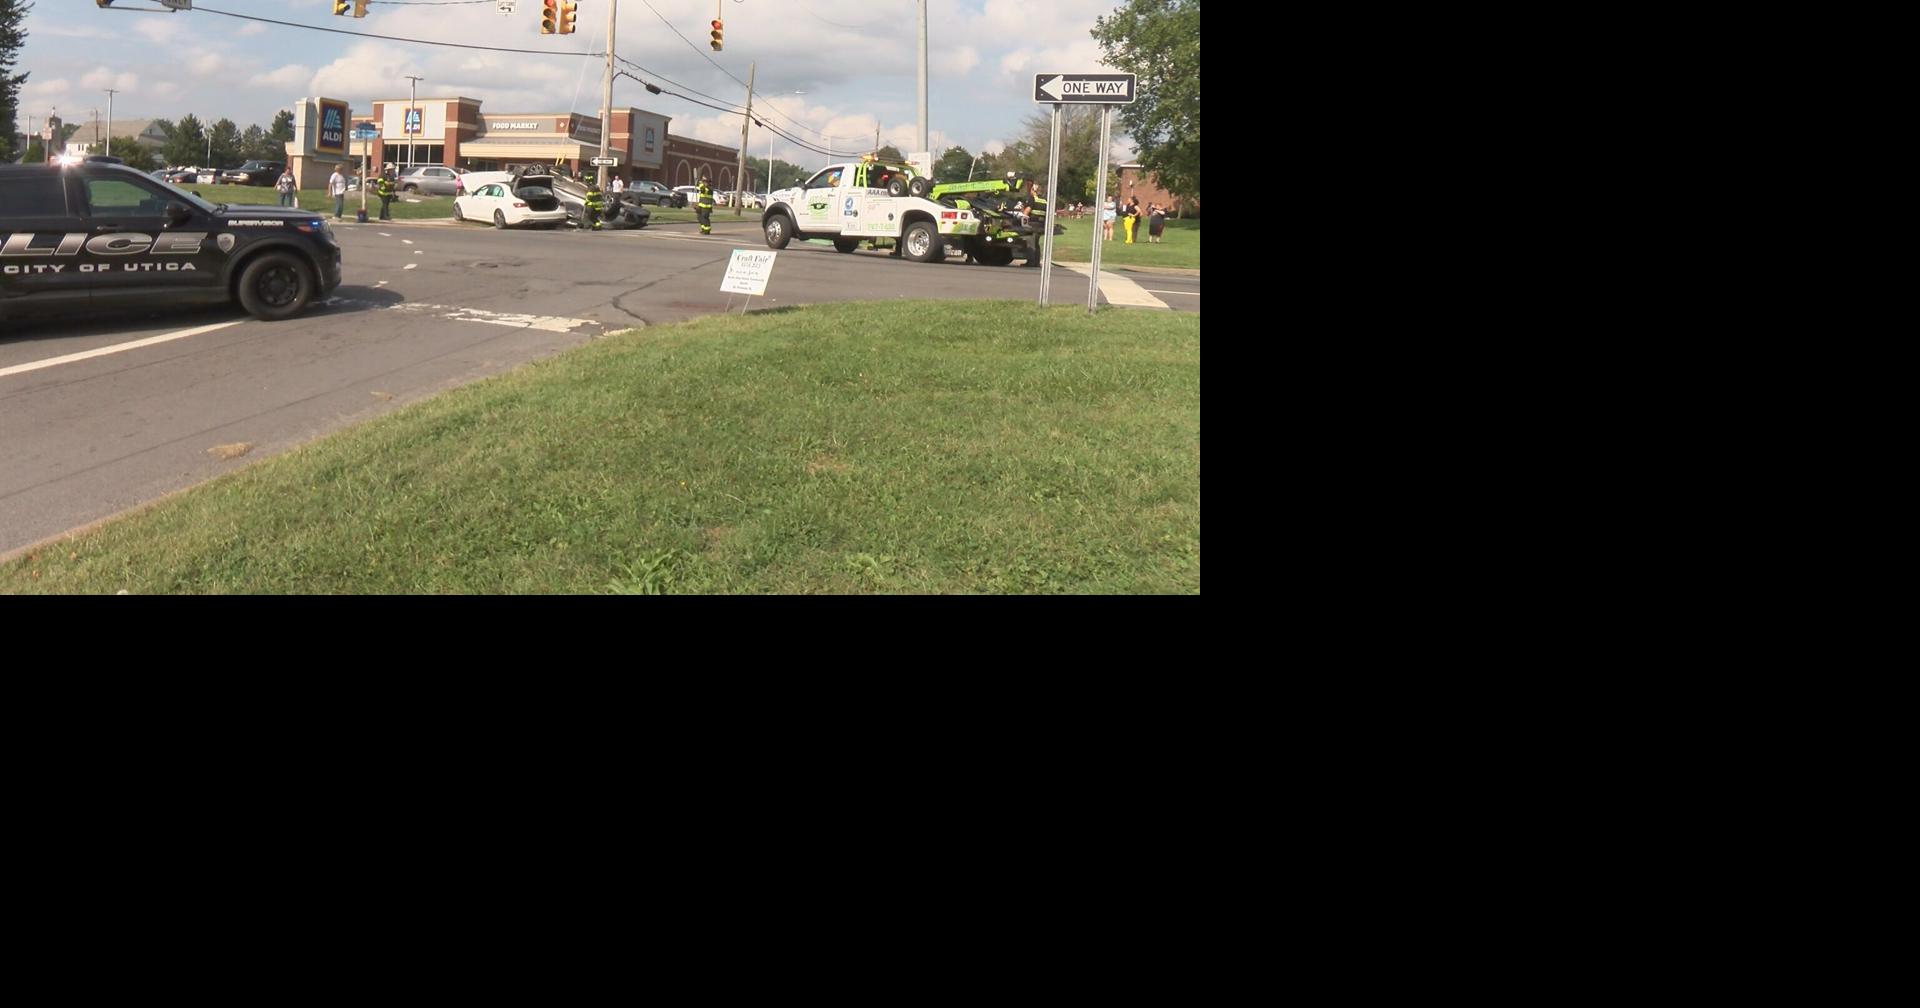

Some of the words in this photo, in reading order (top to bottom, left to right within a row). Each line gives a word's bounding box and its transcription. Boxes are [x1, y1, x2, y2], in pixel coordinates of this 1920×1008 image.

[1063, 82, 1090, 93] ONE
[1096, 82, 1124, 93] WAY
[323, 130, 343, 142] ALDI
[0, 232, 208, 256] LICE
[4, 264, 65, 274] CITY
[79, 263, 110, 272] OF
[124, 262, 196, 272] UTICA
